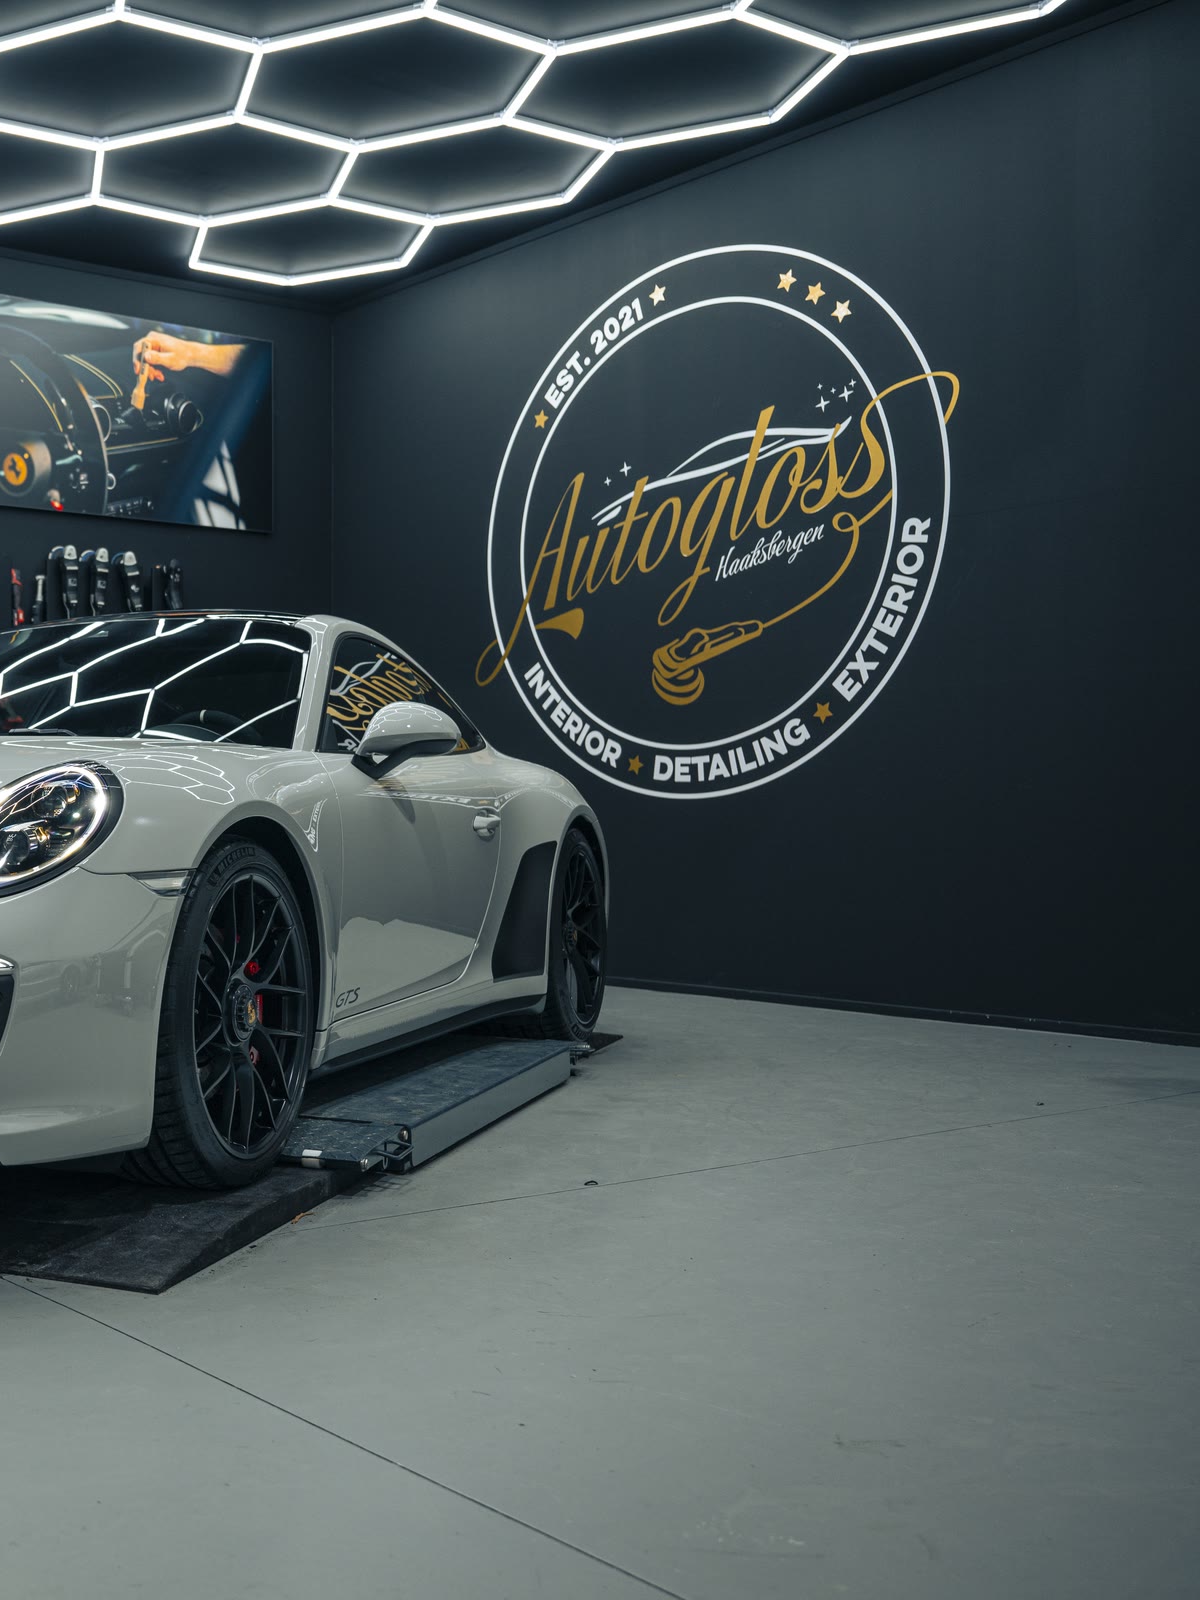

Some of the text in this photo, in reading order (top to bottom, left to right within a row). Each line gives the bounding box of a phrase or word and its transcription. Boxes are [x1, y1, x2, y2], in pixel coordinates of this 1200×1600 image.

[544, 297, 644, 409] EST. 2021
[476, 372, 958, 686] Autogloss
[715, 523, 825, 582] Haaksbergen
[524, 517, 931, 783] INTERIOR DETAILING EXTERIOR
[217, 846, 257, 874] MICHELIN
[335, 987, 361, 1008] GTS
